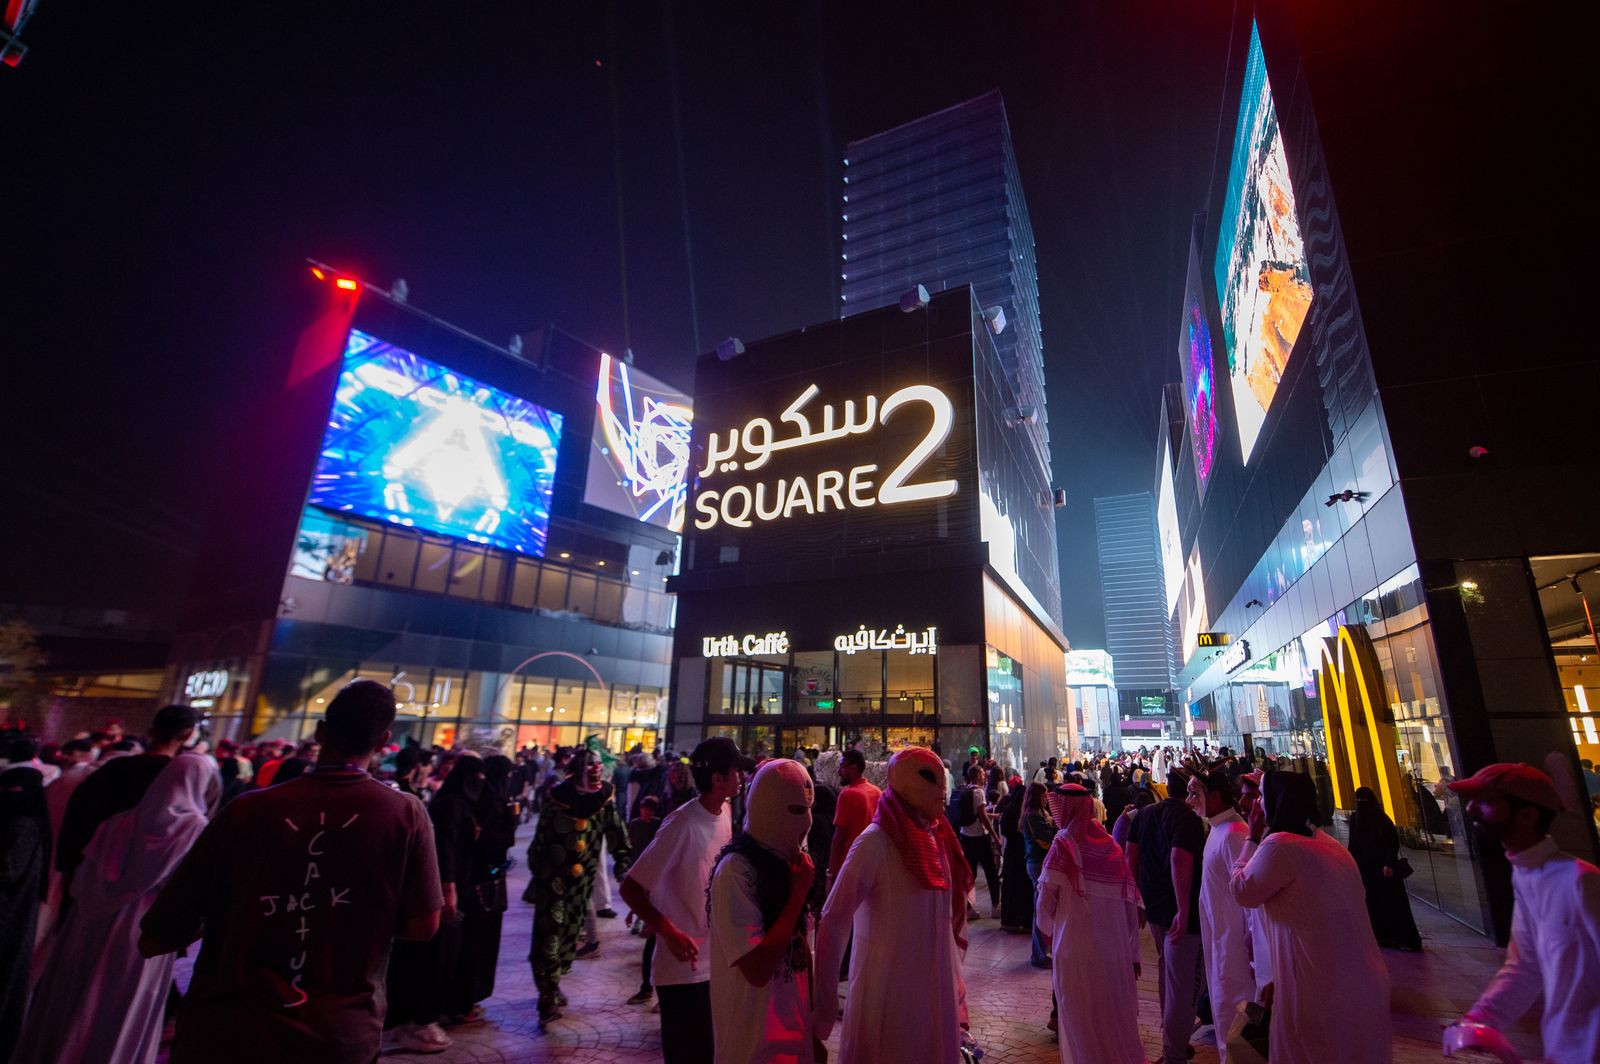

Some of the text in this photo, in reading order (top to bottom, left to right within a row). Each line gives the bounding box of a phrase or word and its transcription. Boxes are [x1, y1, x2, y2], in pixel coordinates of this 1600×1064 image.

[694, 384, 958, 530] SQUARE 2
[698, 384, 877, 478] سكوير
[703, 631, 788, 658] Urth Caffé
[834, 625, 892, 655] كافيه
